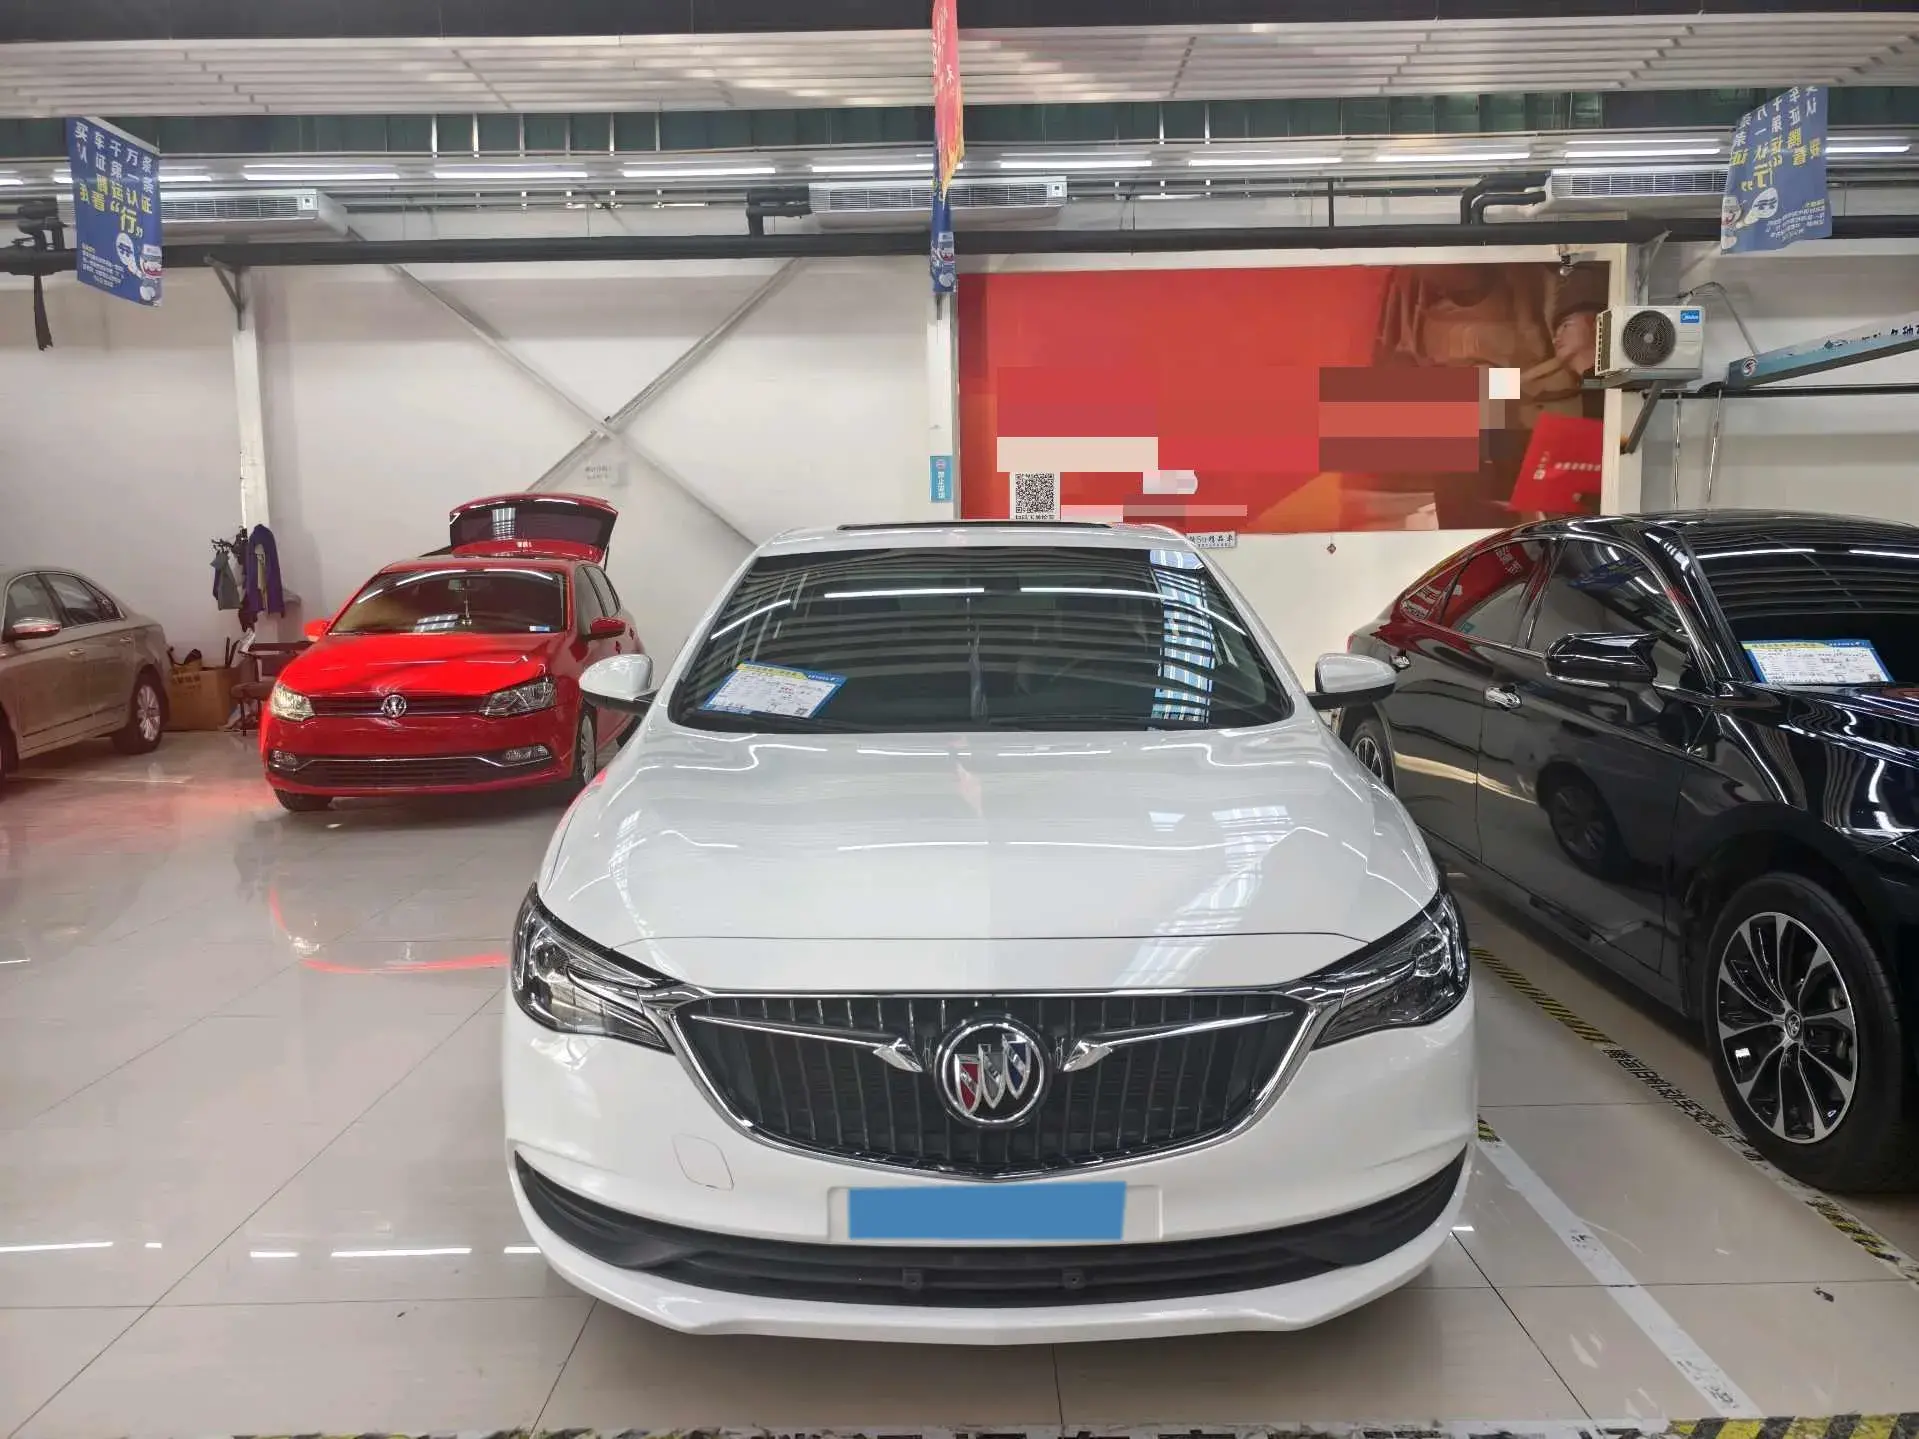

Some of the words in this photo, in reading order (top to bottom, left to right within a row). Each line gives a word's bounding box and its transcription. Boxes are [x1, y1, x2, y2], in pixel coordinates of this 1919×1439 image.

[74, 122, 153, 176] 买车千万条
